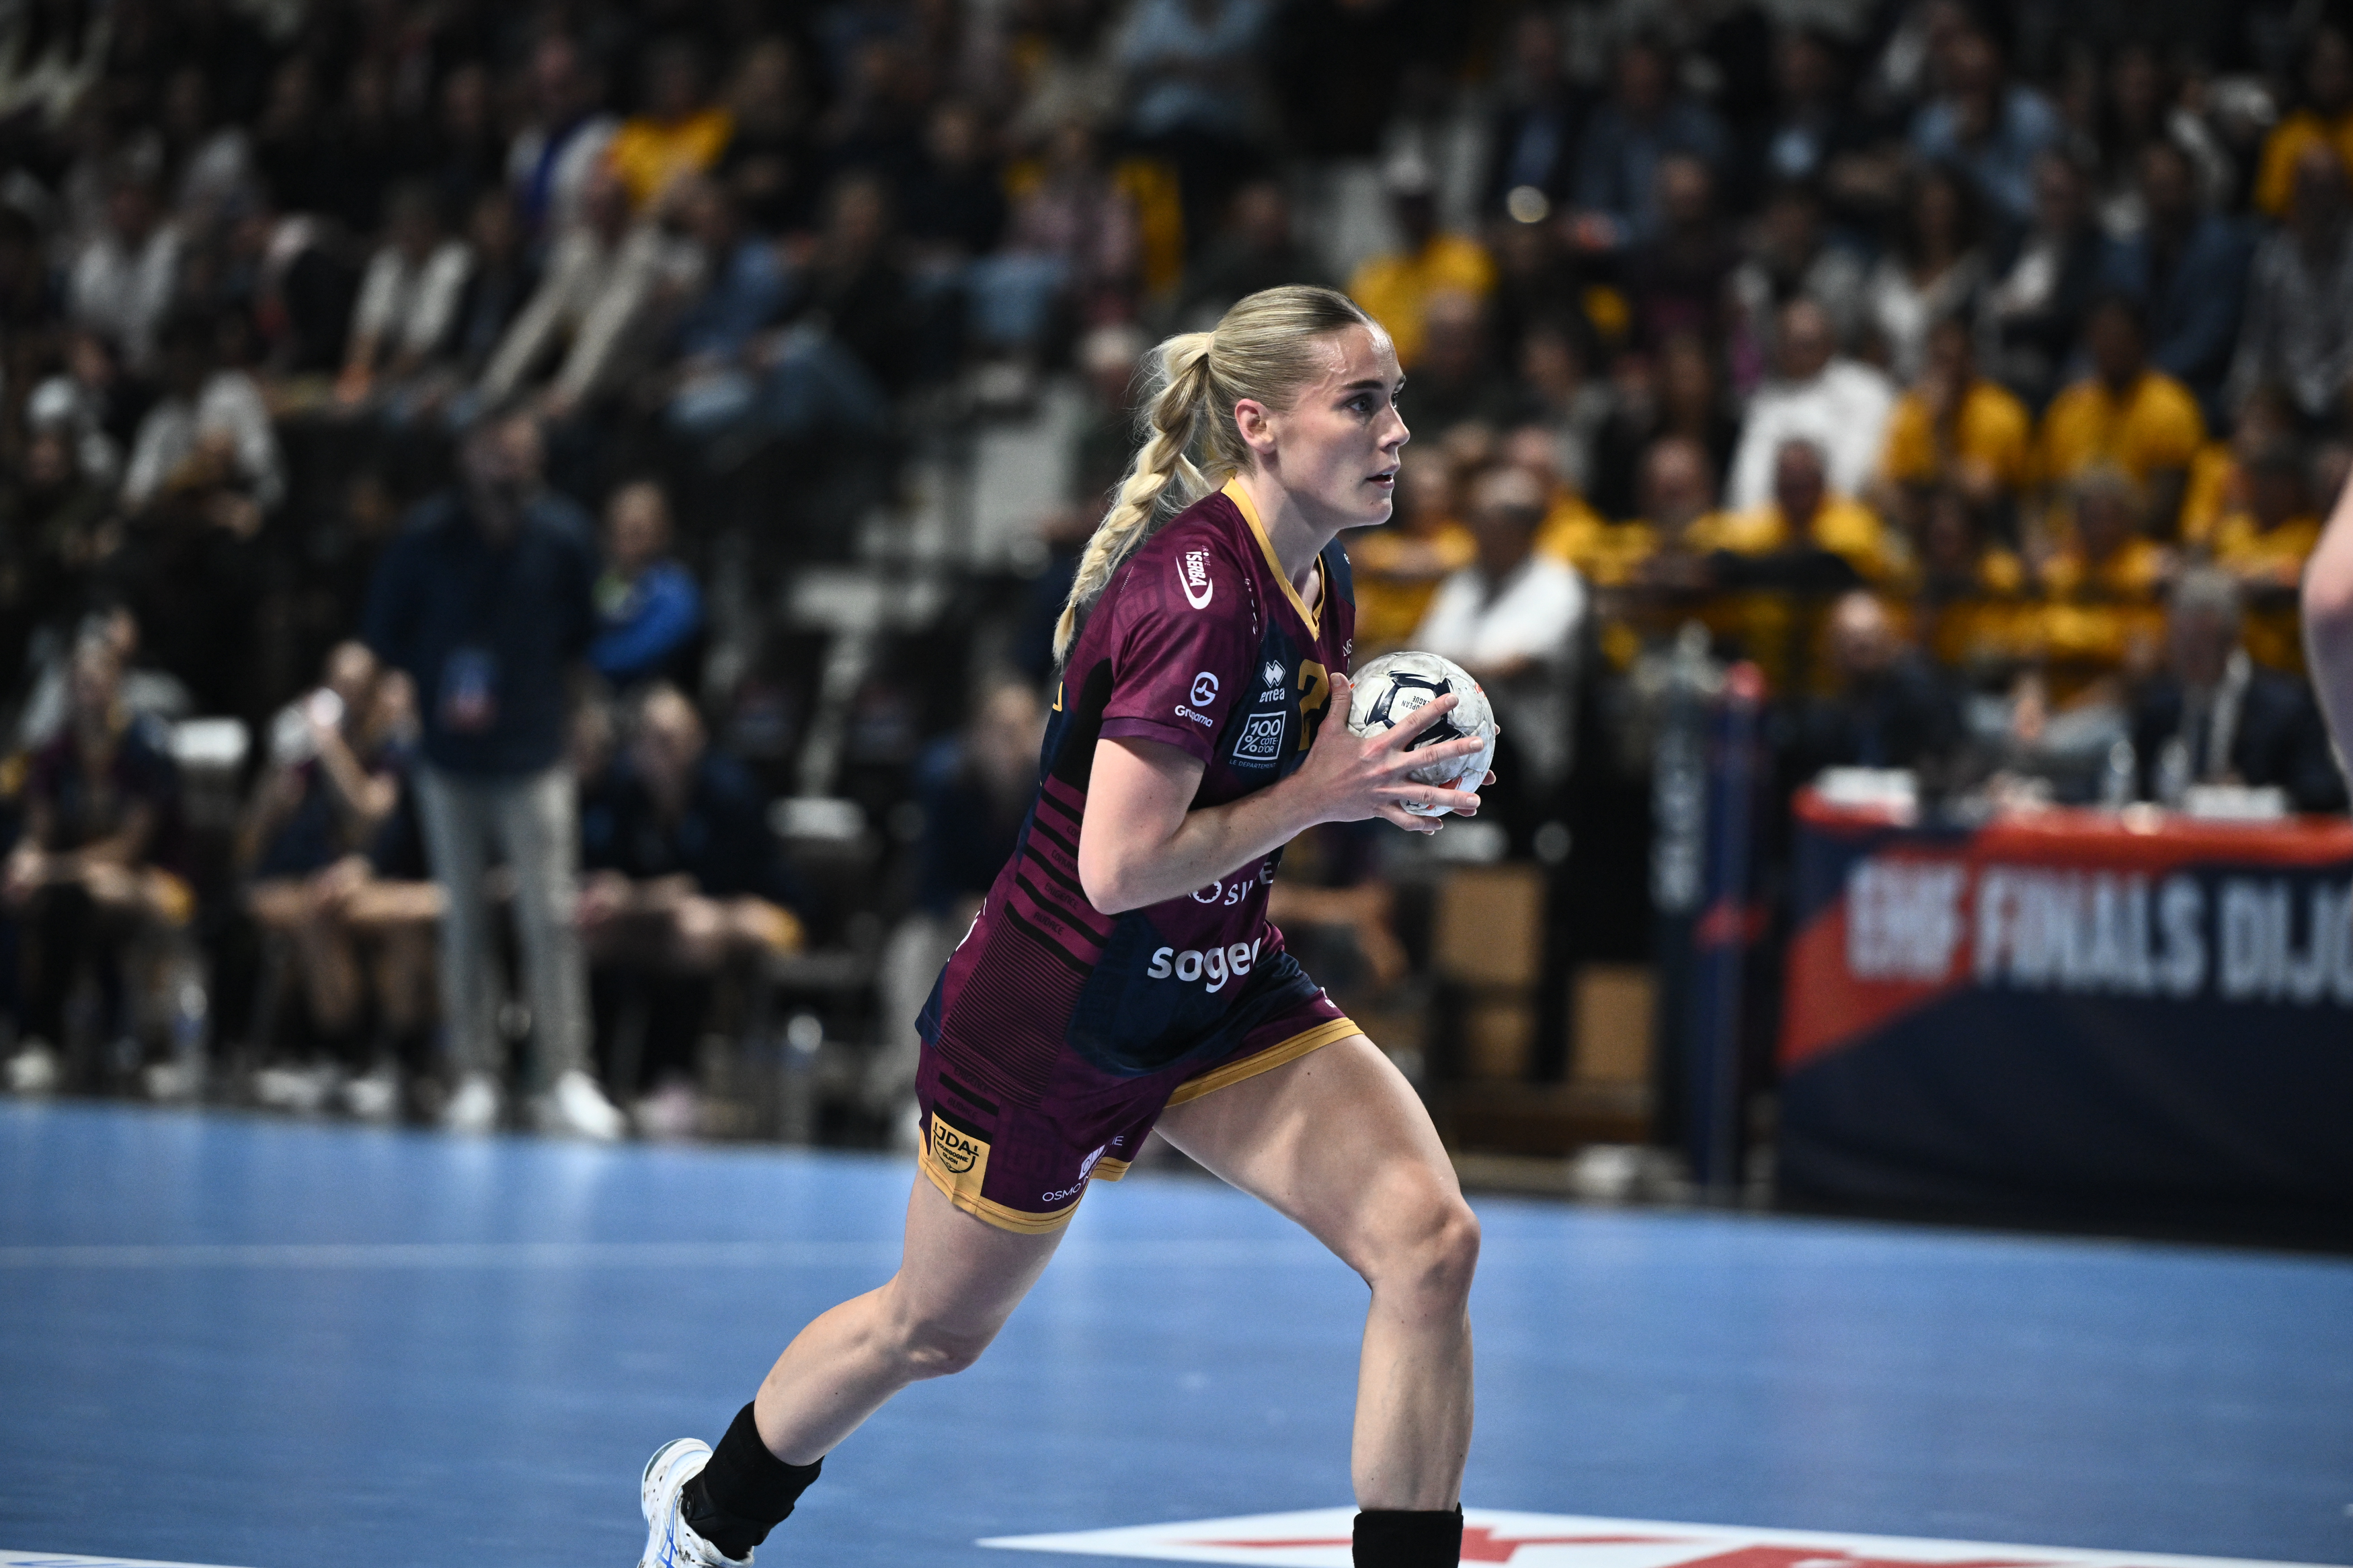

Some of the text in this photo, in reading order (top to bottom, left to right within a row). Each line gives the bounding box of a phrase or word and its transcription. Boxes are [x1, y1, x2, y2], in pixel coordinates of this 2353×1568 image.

[1185, 551, 1207, 587] ISERBA
[1401, 700, 1421, 710] OPEAN
[1412, 696, 1430, 706] AGUE
[1250, 719, 1281, 737] 100
[936, 1141, 969, 1163] BOURGOGNE
[943, 1152, 959, 1165] DIJON
